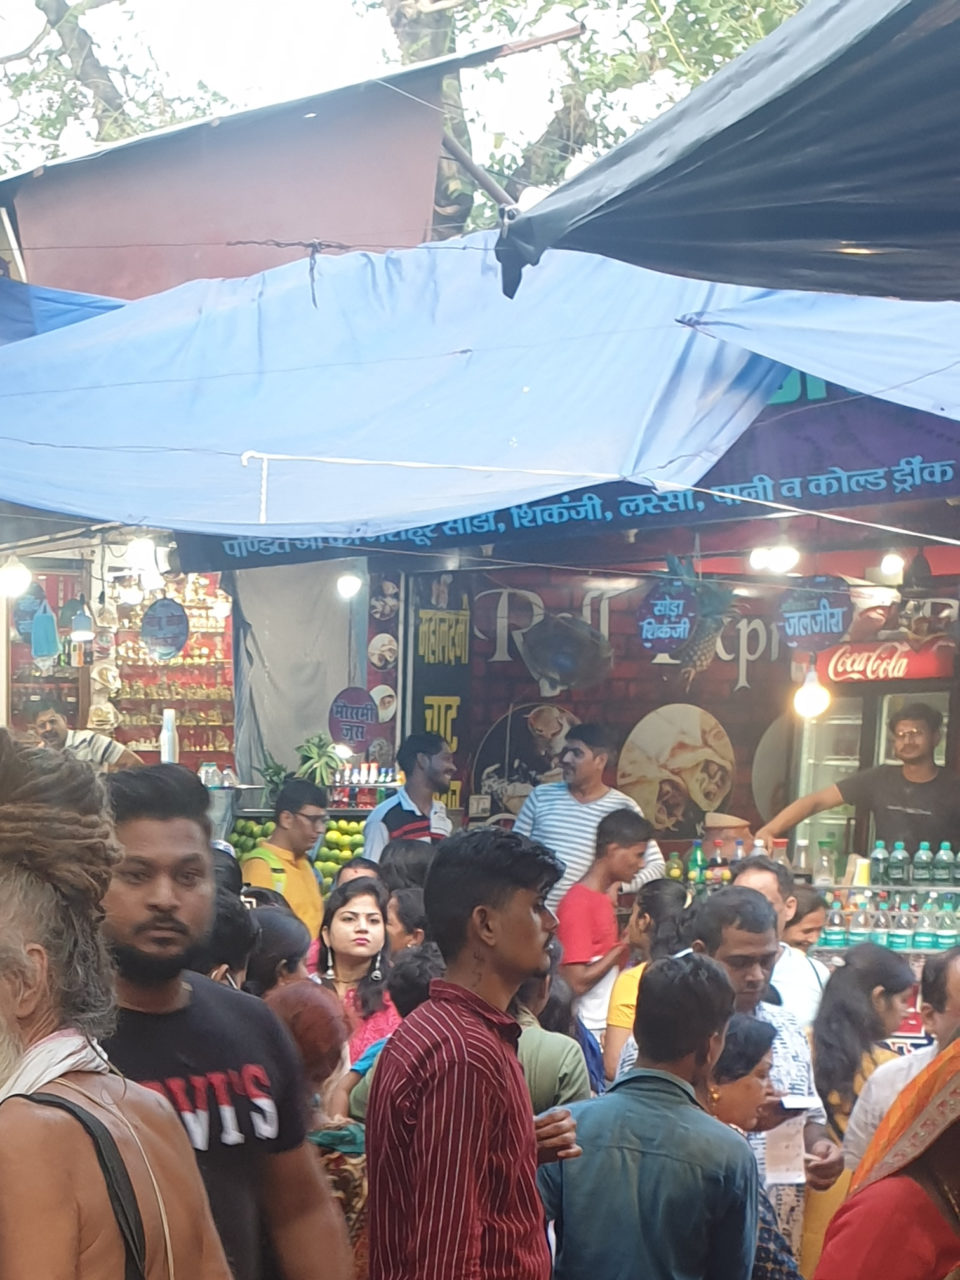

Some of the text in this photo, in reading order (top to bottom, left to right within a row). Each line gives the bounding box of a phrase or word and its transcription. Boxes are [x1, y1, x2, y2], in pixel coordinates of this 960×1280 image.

[778, 476, 804, 499] व
[807, 466, 889, 497] कोल्ड
[639, 617, 690, 639] शिकंजी
[783, 597, 847, 636] जलजीरा
